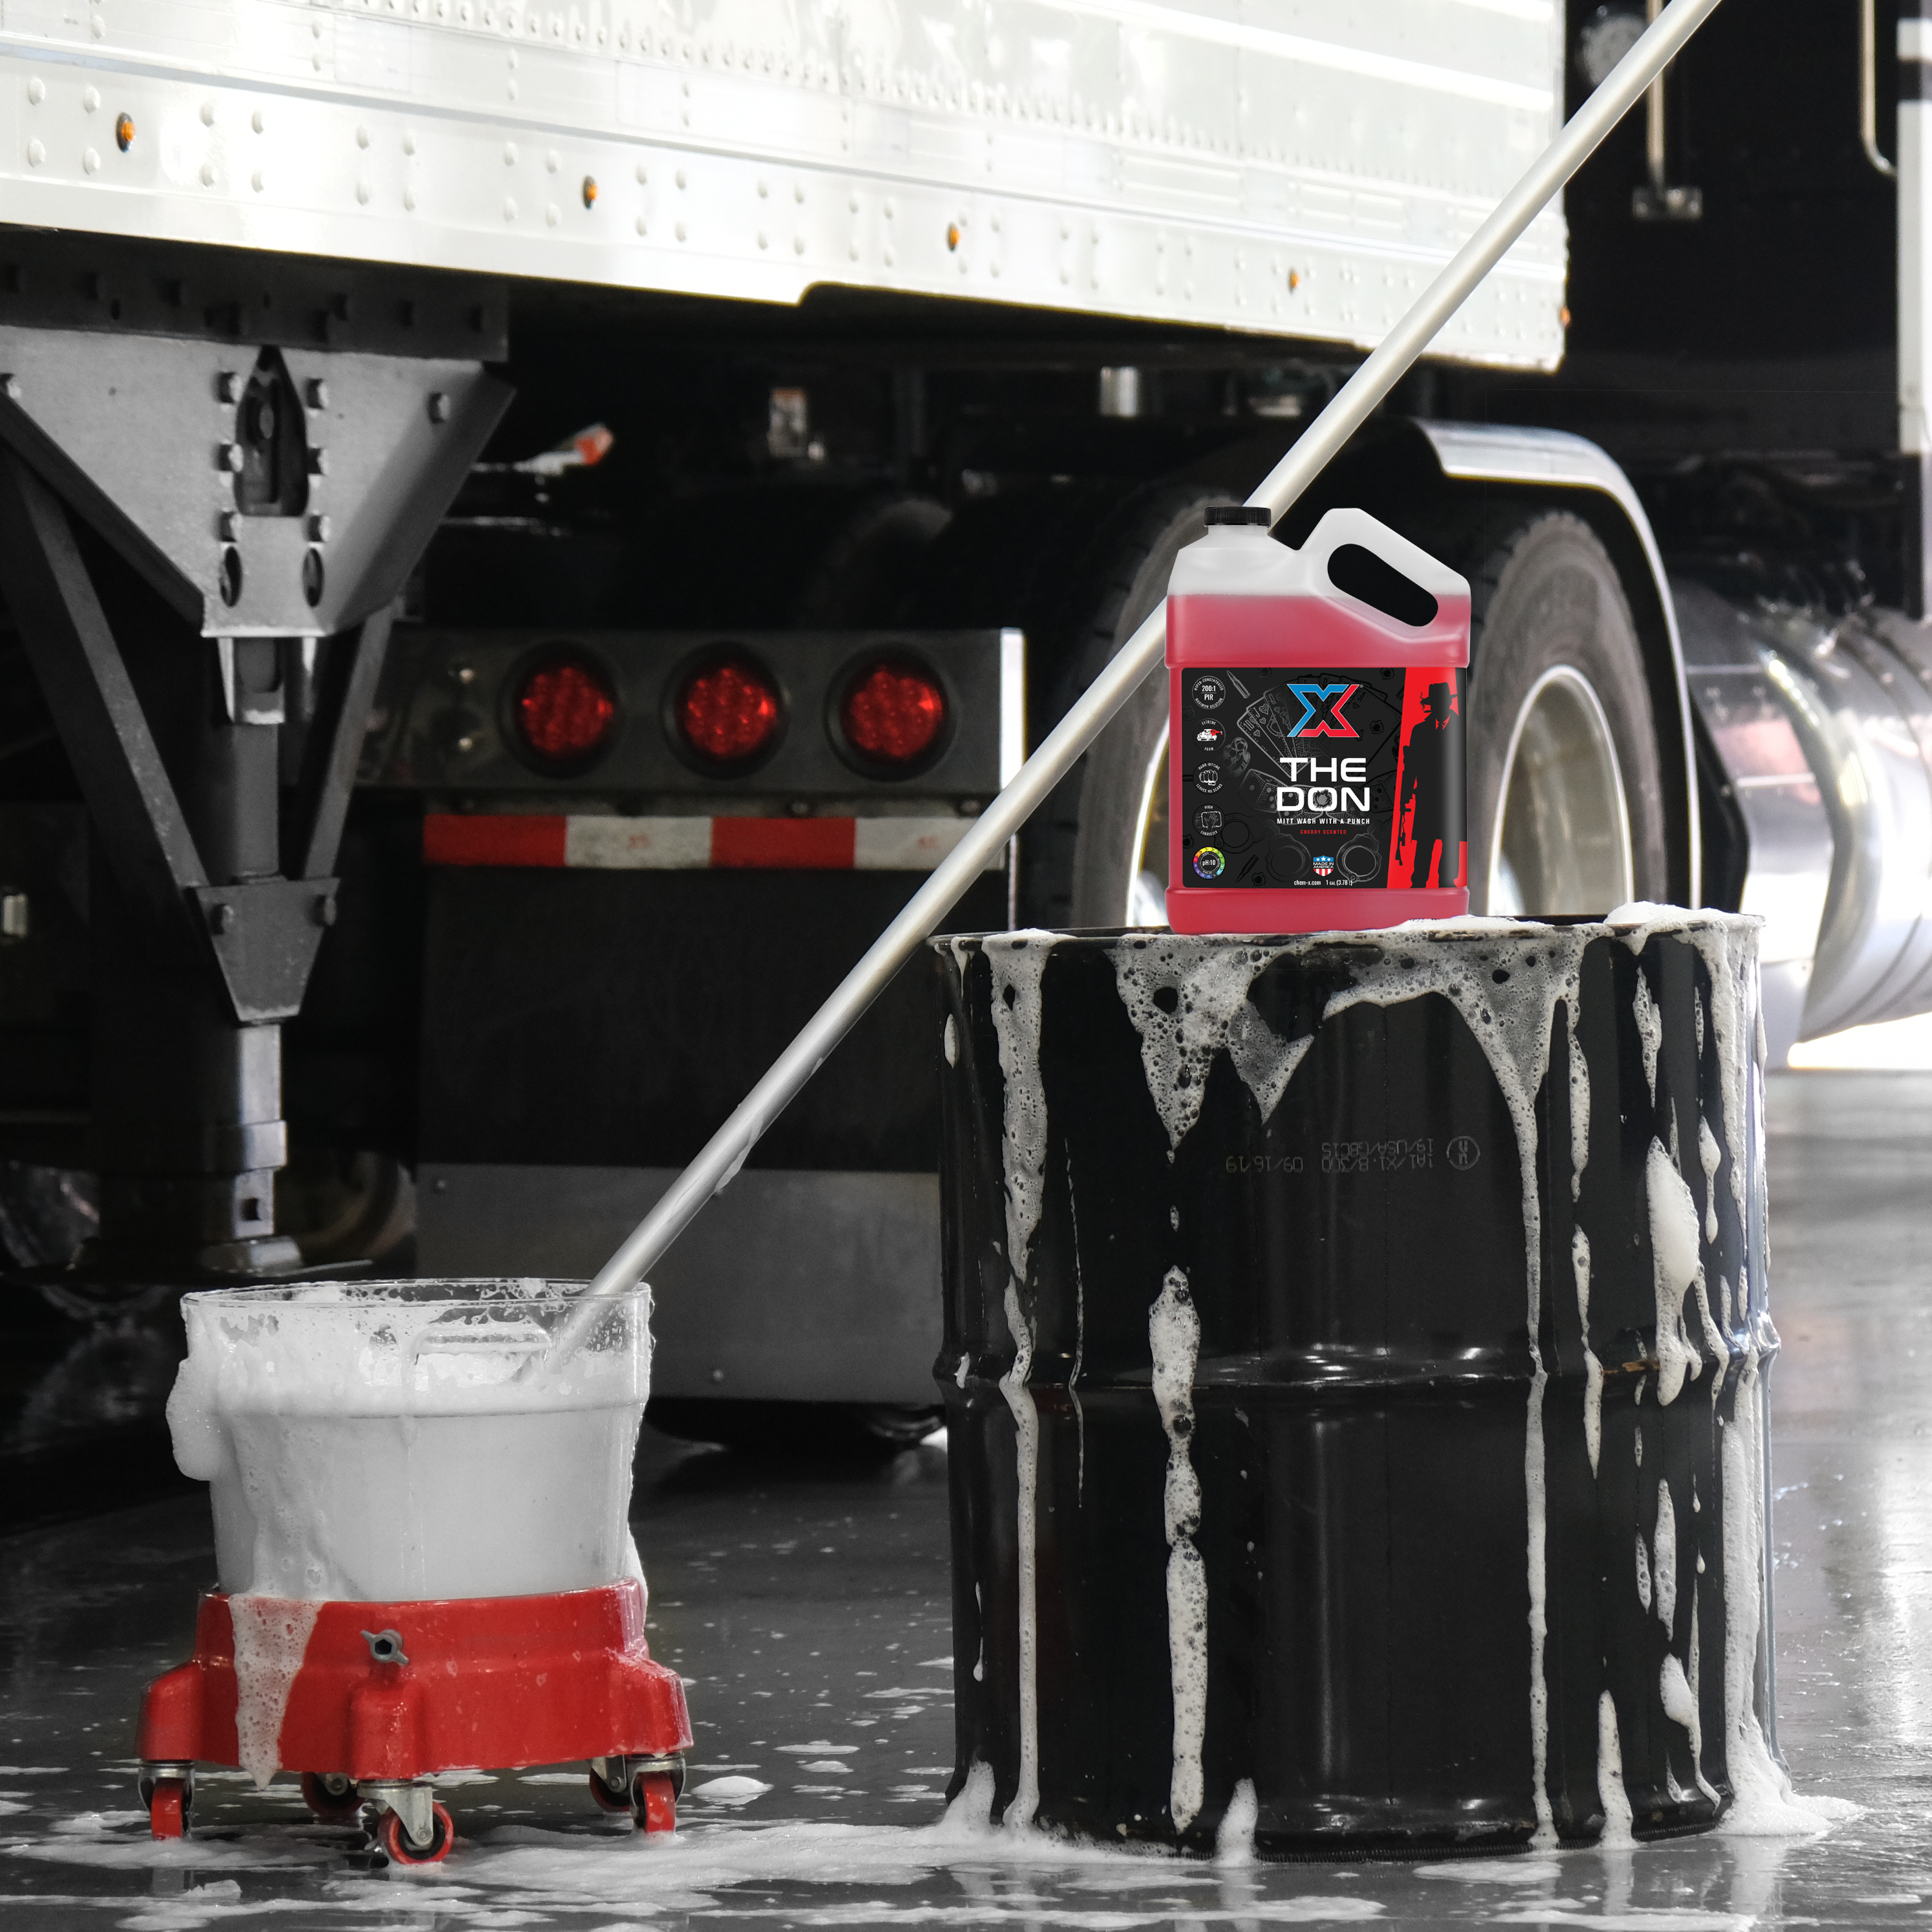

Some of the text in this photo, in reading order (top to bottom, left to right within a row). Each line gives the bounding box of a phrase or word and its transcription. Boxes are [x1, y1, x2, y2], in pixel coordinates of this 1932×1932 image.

[1280, 757, 1367, 783] THE
[1196, 784, 1208, 794] LEAVES
[1213, 784, 1223, 793] SCARS
[1277, 787, 1371, 811] DON
[1225, 1155, 1305, 1173] 09/16/19
